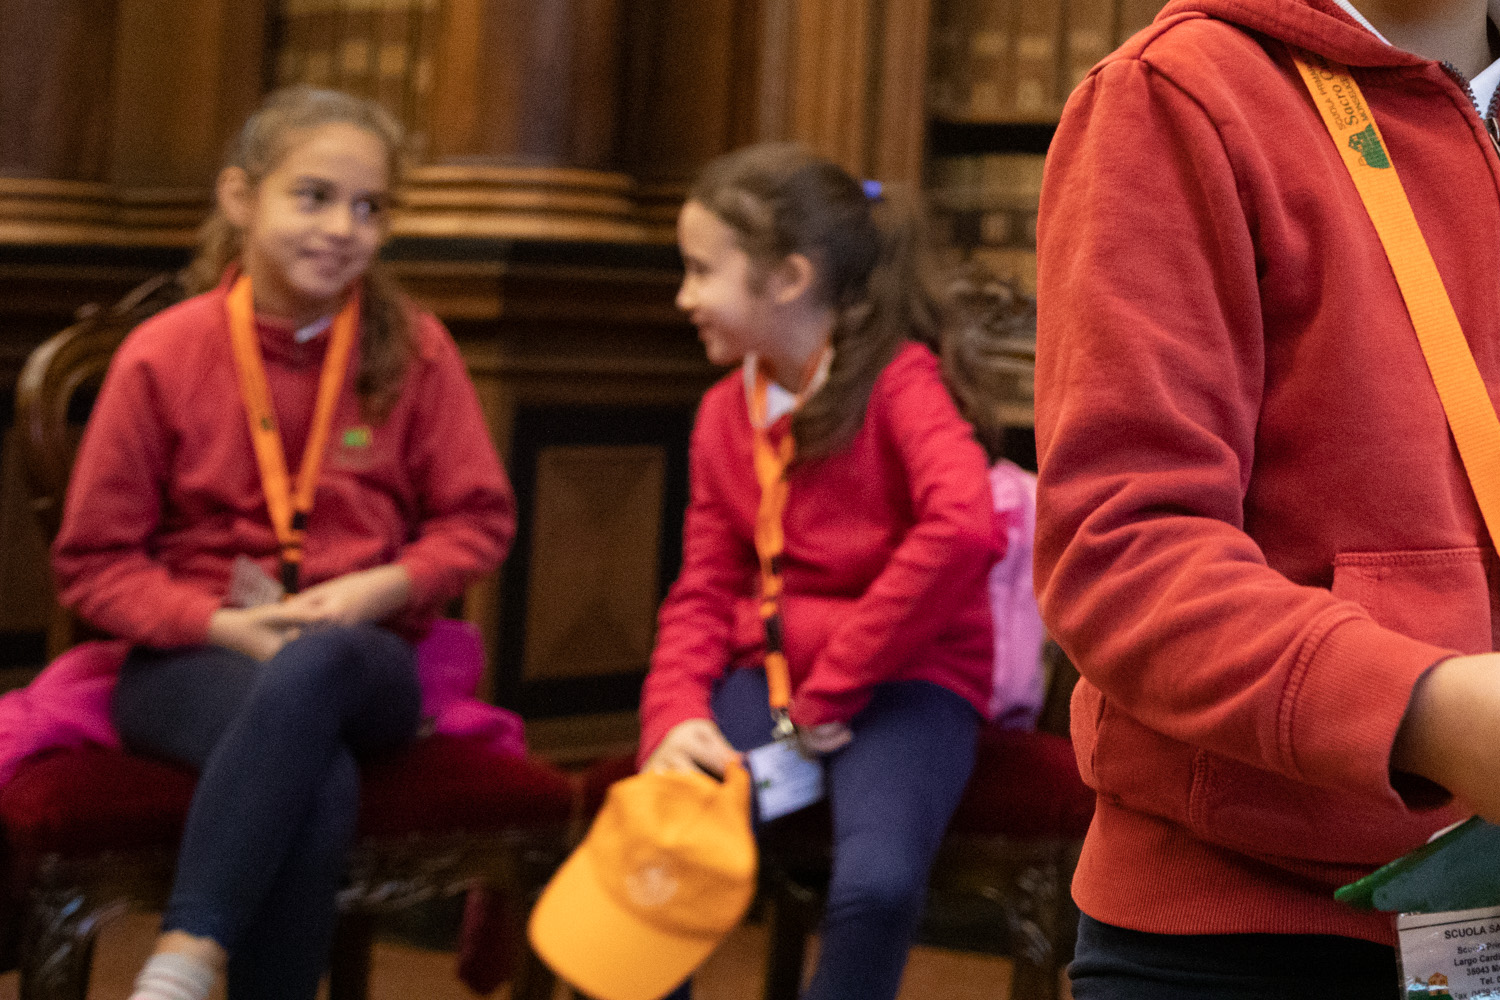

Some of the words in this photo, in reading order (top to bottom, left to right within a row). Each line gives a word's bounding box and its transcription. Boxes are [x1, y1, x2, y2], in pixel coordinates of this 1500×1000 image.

[1331, 84, 1359, 127] Sacro
[1325, 97, 1347, 131] SCUOLA
[1444, 925, 1487, 939] SCUOLA
[1453, 957, 1478, 967] Largo
[1479, 976, 1494, 985] Tel.
